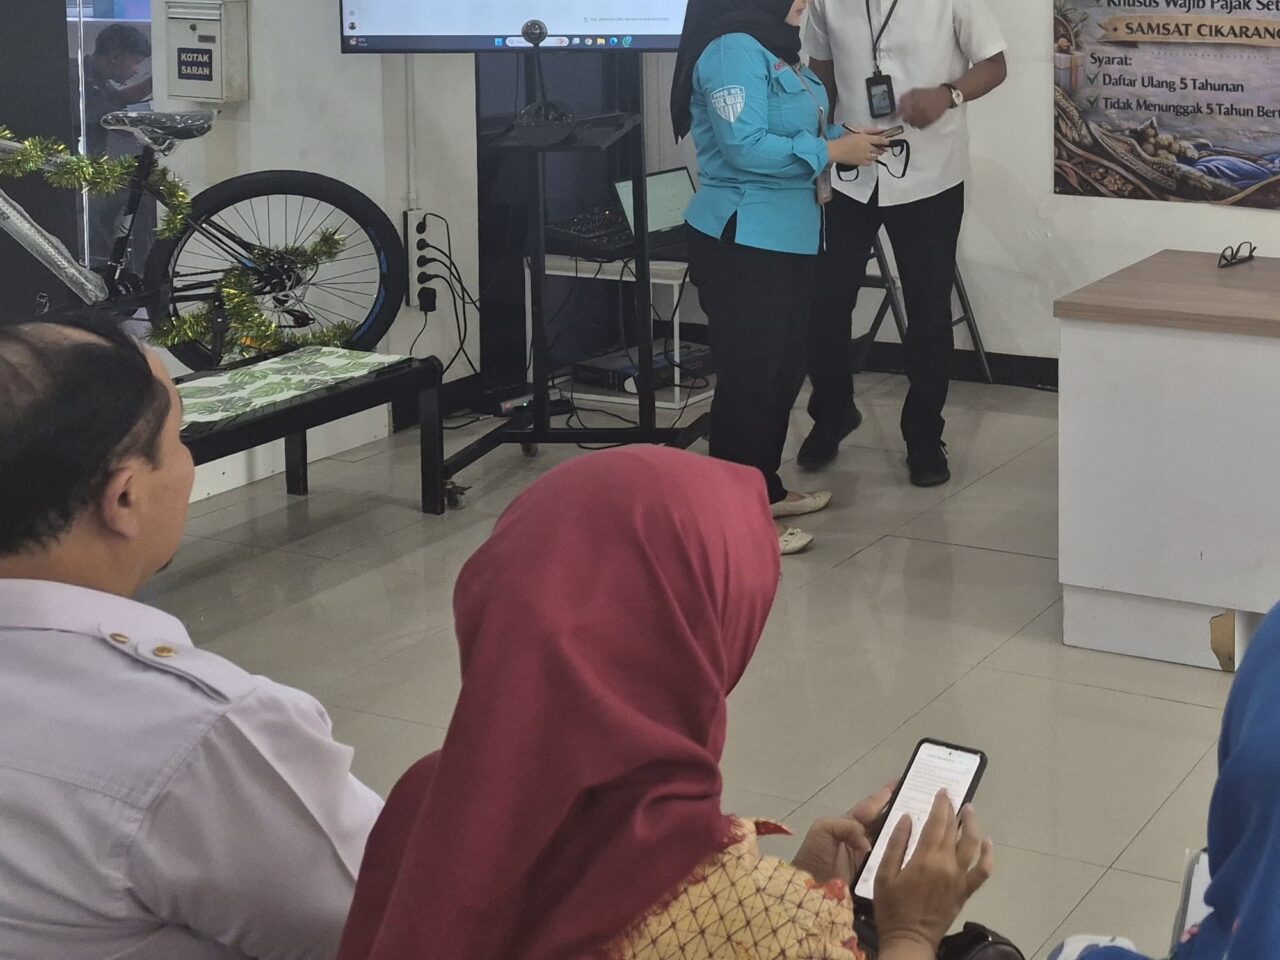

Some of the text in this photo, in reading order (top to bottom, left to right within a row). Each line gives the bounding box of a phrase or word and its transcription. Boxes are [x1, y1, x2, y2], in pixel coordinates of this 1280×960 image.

[1124, 21, 1192, 37] SAMSAT
[180, 52, 209, 63] KOTAK
[1089, 52, 1133, 68] Syarat:
[180, 65, 210, 76] SARAN
[1102, 73, 1245, 93] Daftar Ulang 5 Tahunan
[1102, 97, 1133, 111] Tidak
[1136, 99, 1204, 117] Menunggak
[1206, 103, 1214, 115] 5
[1215, 103, 1254, 118] Tahun
